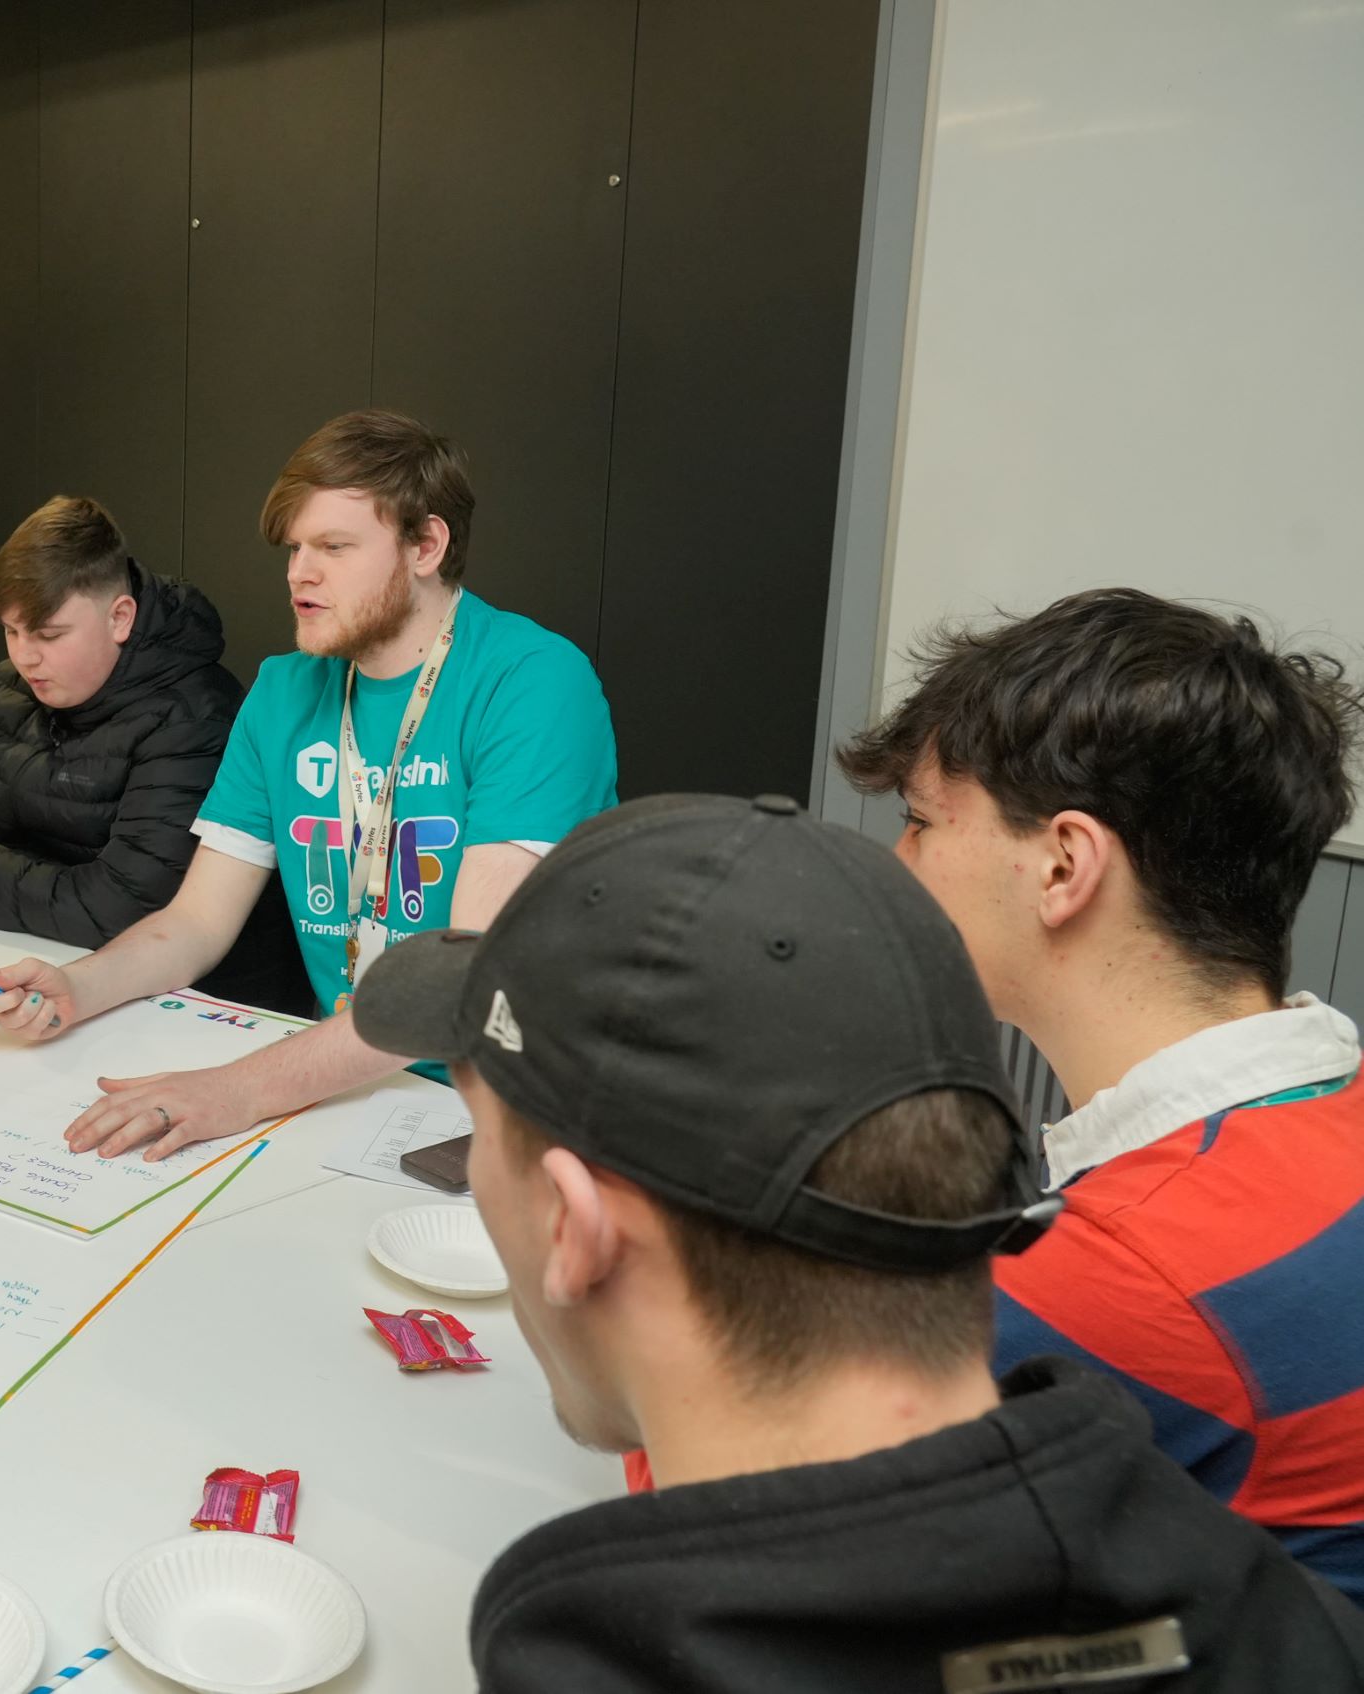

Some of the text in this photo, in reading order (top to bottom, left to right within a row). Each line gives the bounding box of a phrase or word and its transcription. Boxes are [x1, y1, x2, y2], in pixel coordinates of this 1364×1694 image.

[424, 666, 436, 686] bytes
[405, 720, 416, 742] bytes
[355, 783, 363, 803] bytes
[366, 827, 376, 846] bytes
[197, 1011, 260, 1030] TYF
[26, 1172, 79, 1193] YOUNG
[20, 1186, 69, 1203] WHAT
